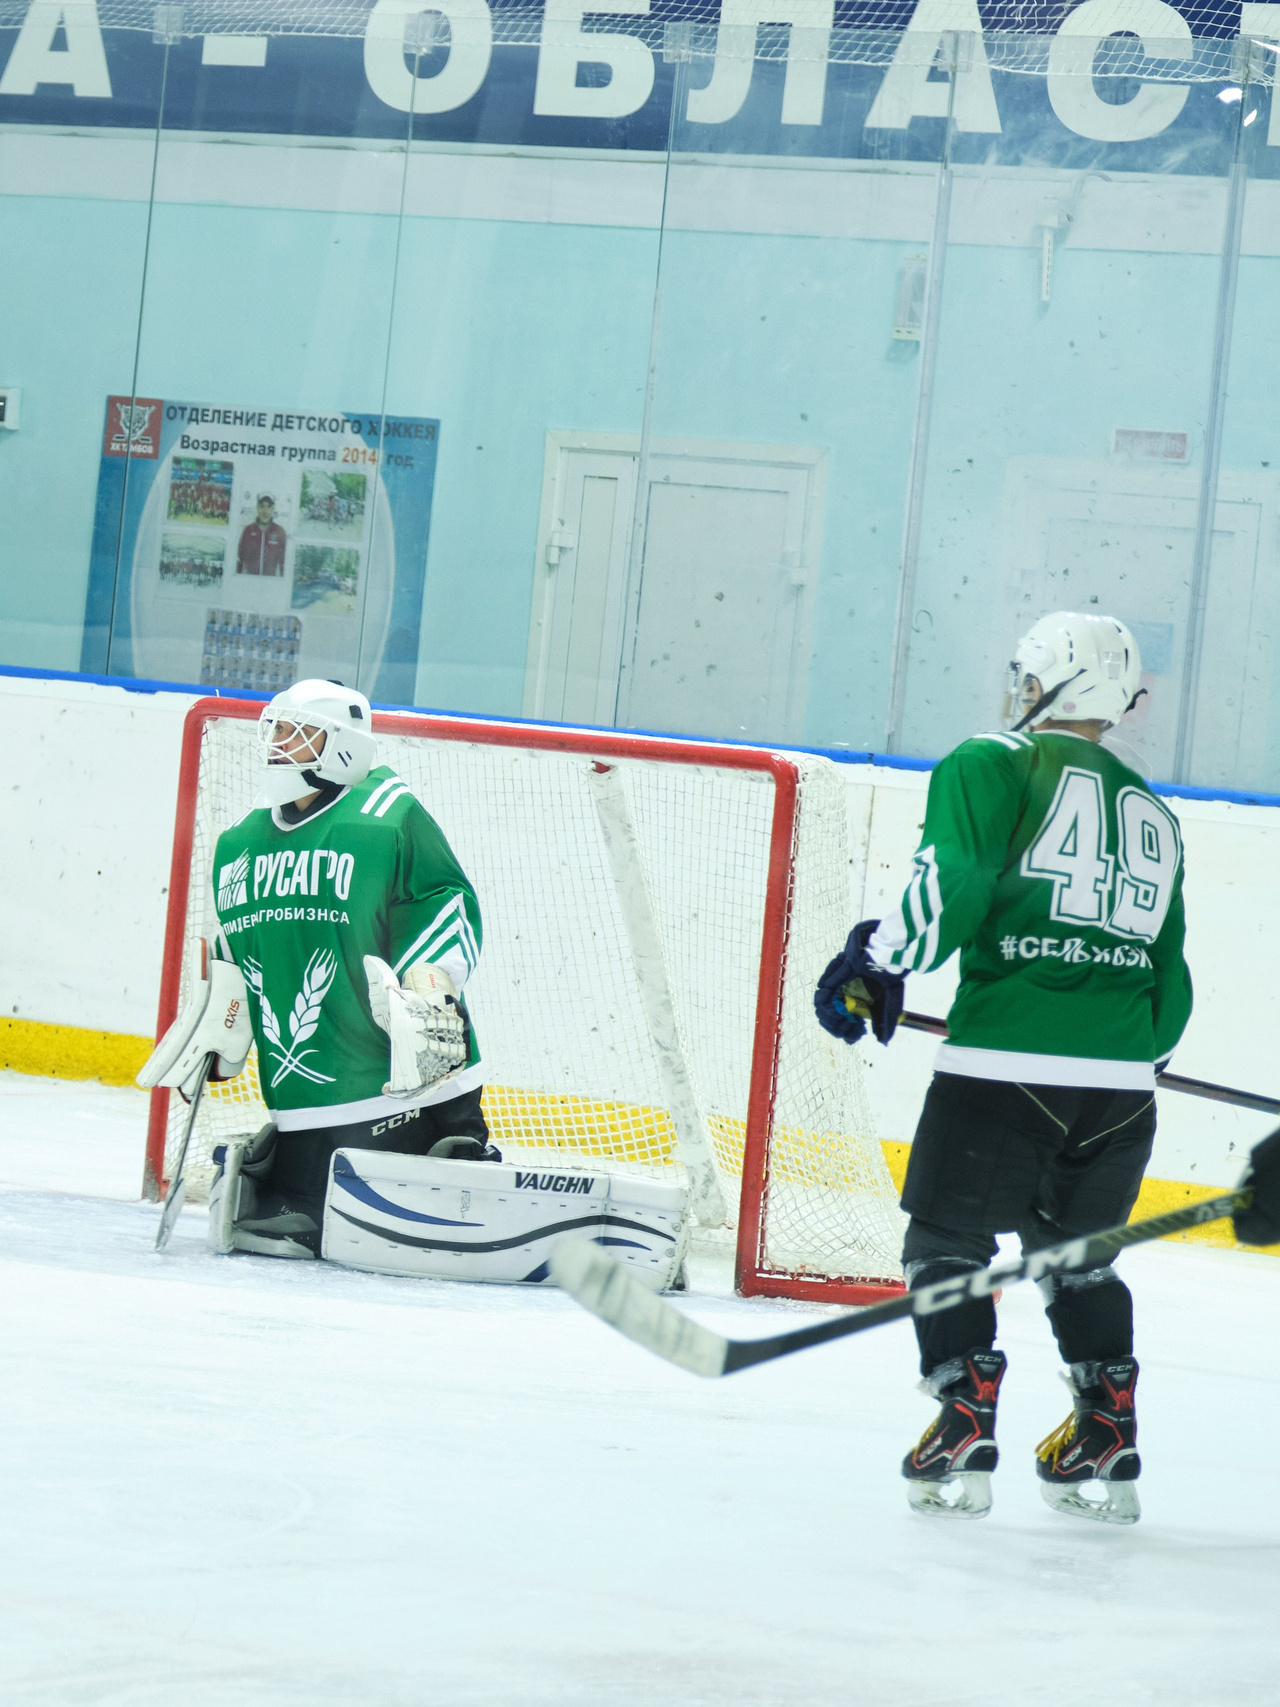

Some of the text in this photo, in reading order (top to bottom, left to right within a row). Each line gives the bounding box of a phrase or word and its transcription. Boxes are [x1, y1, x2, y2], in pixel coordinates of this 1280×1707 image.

[202, 35, 268, 67] -
[166, 405, 436, 441] ОТДЕЛЕНИЕ ДЕТСКОГО ХОККЕЯ
[110, 442, 121, 452] ХК
[180, 433, 414, 469] Возрастная группа 2014 год
[1019, 765, 1182, 945] 49
[253, 849, 355, 901] РУСАГРО
[254, 907, 350, 925] ГРОБИЗНСА
[370, 1108, 421, 1137] CCM
[514, 1171, 595, 1195] VAUGHN
[913, 1239, 1088, 1317] CCM
[973, 1354, 1003, 1363] CCM
[1106, 1363, 1135, 1374] CCM
[1061, 1446, 1083, 1468] CCM
